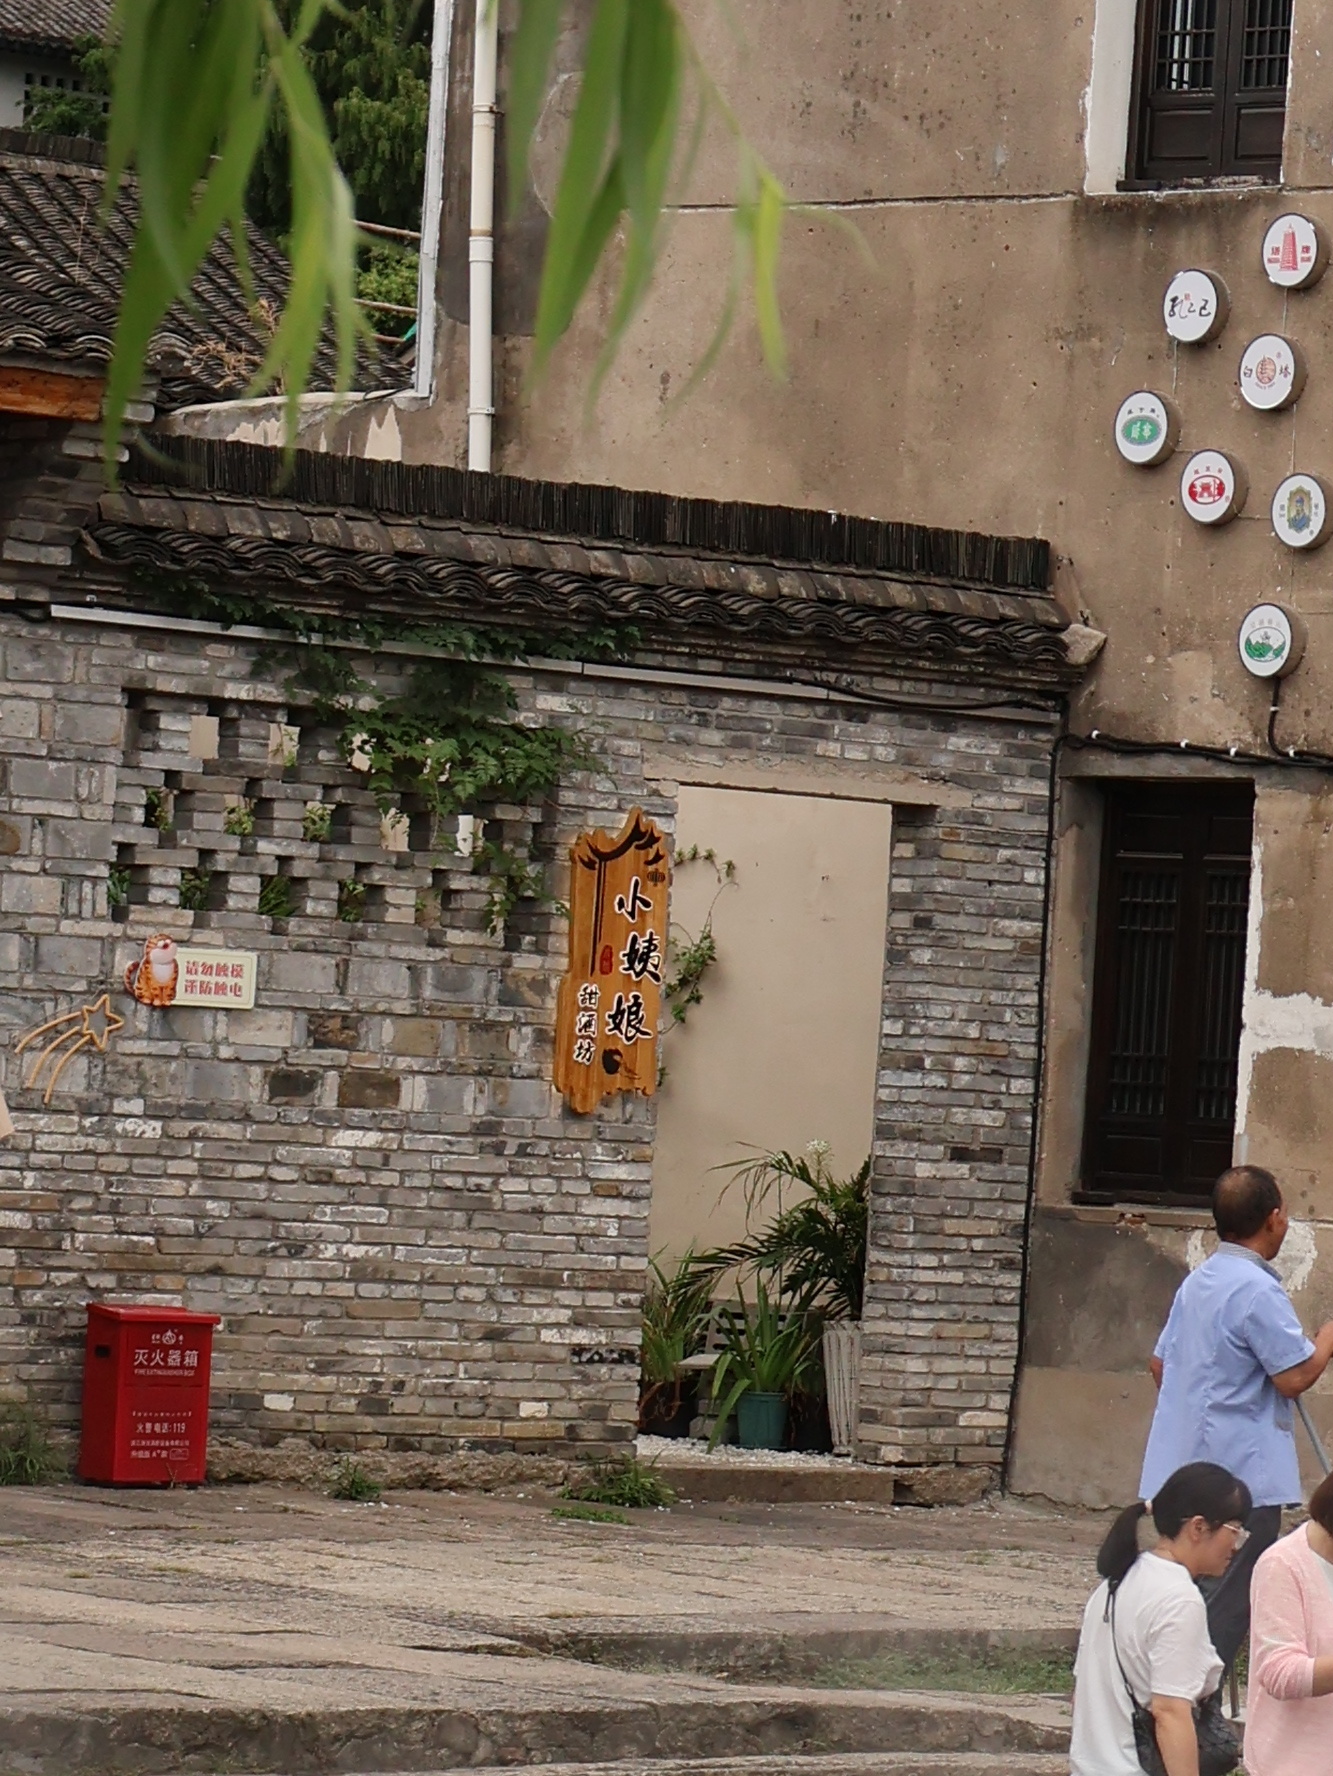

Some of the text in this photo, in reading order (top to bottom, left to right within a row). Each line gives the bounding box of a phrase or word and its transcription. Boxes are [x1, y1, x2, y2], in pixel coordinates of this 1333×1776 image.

[186, 961, 244, 978] 请勿触摸
[606, 877, 662, 1044] 小姨娘
[185, 979, 243, 997] 谨防触电
[573, 983, 600, 1066] 甜酒坊
[134, 1349, 198, 1367] 灭火器箱
